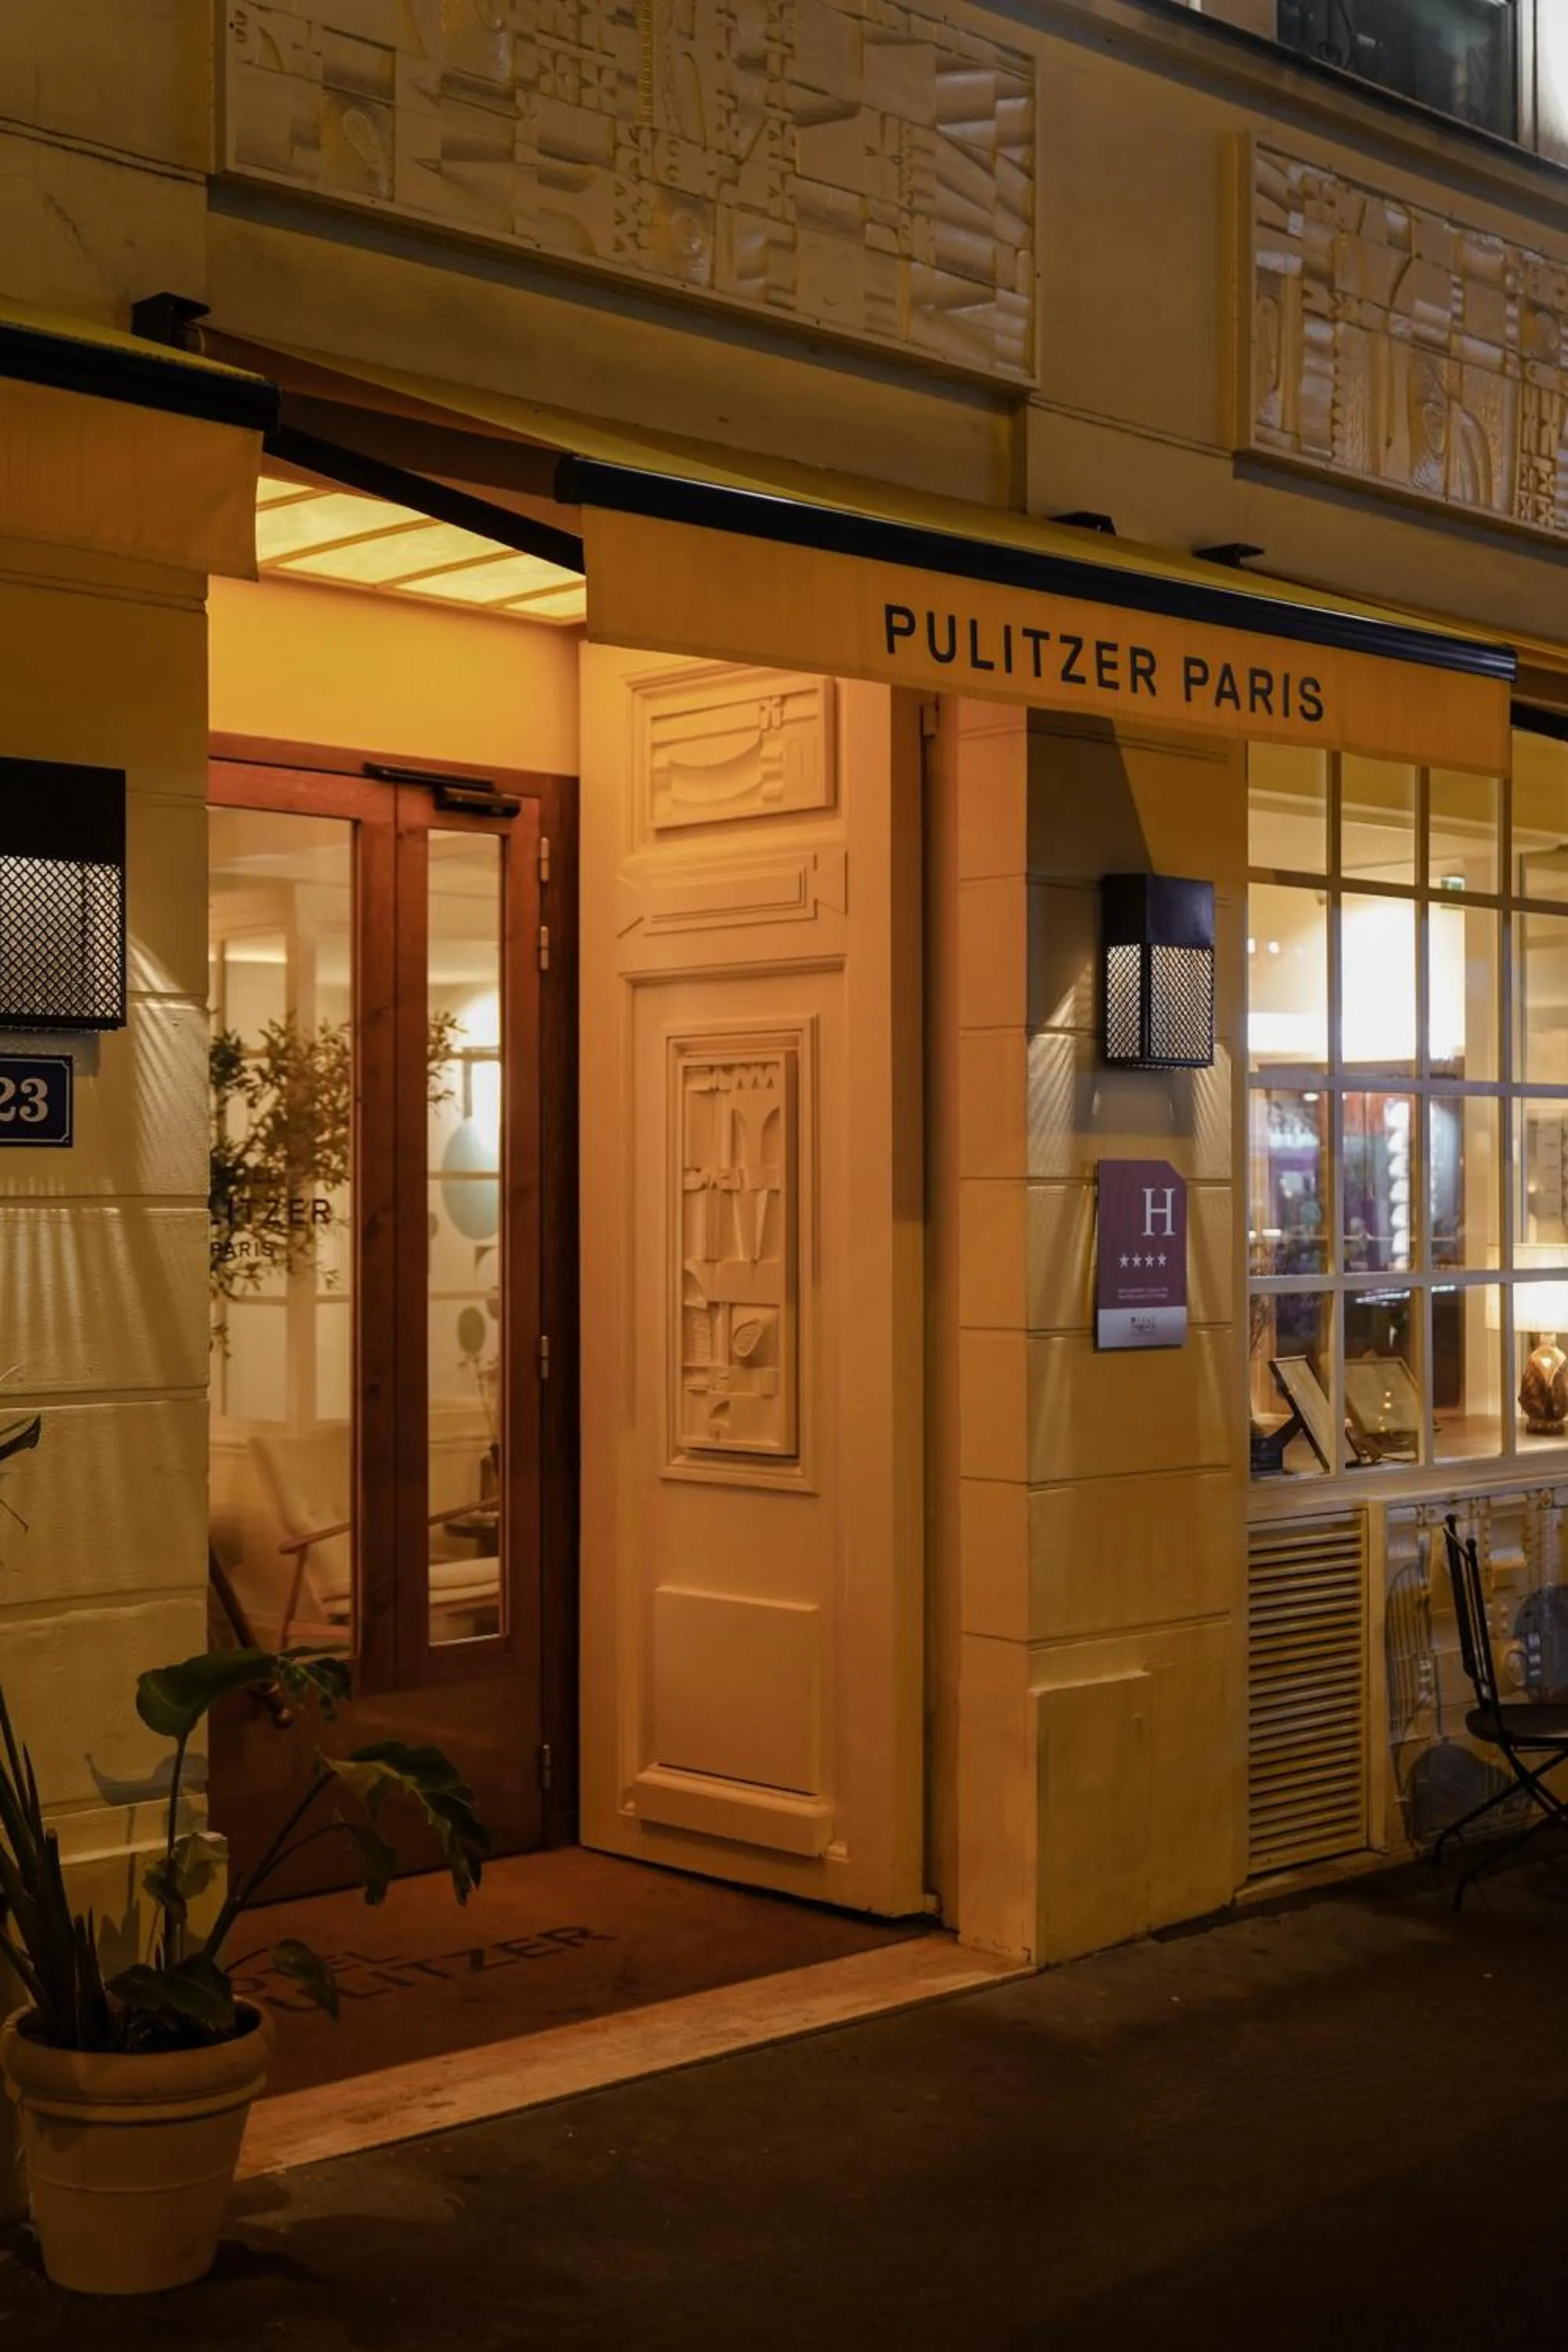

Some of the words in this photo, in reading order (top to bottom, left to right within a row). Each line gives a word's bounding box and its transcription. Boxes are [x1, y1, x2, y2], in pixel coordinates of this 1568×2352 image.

[884, 602, 1157, 697] PULITZER
[1183, 655, 1325, 723] PARIS
[1142, 1188, 1176, 1236] H
[211, 1241, 274, 1258] PARIS
